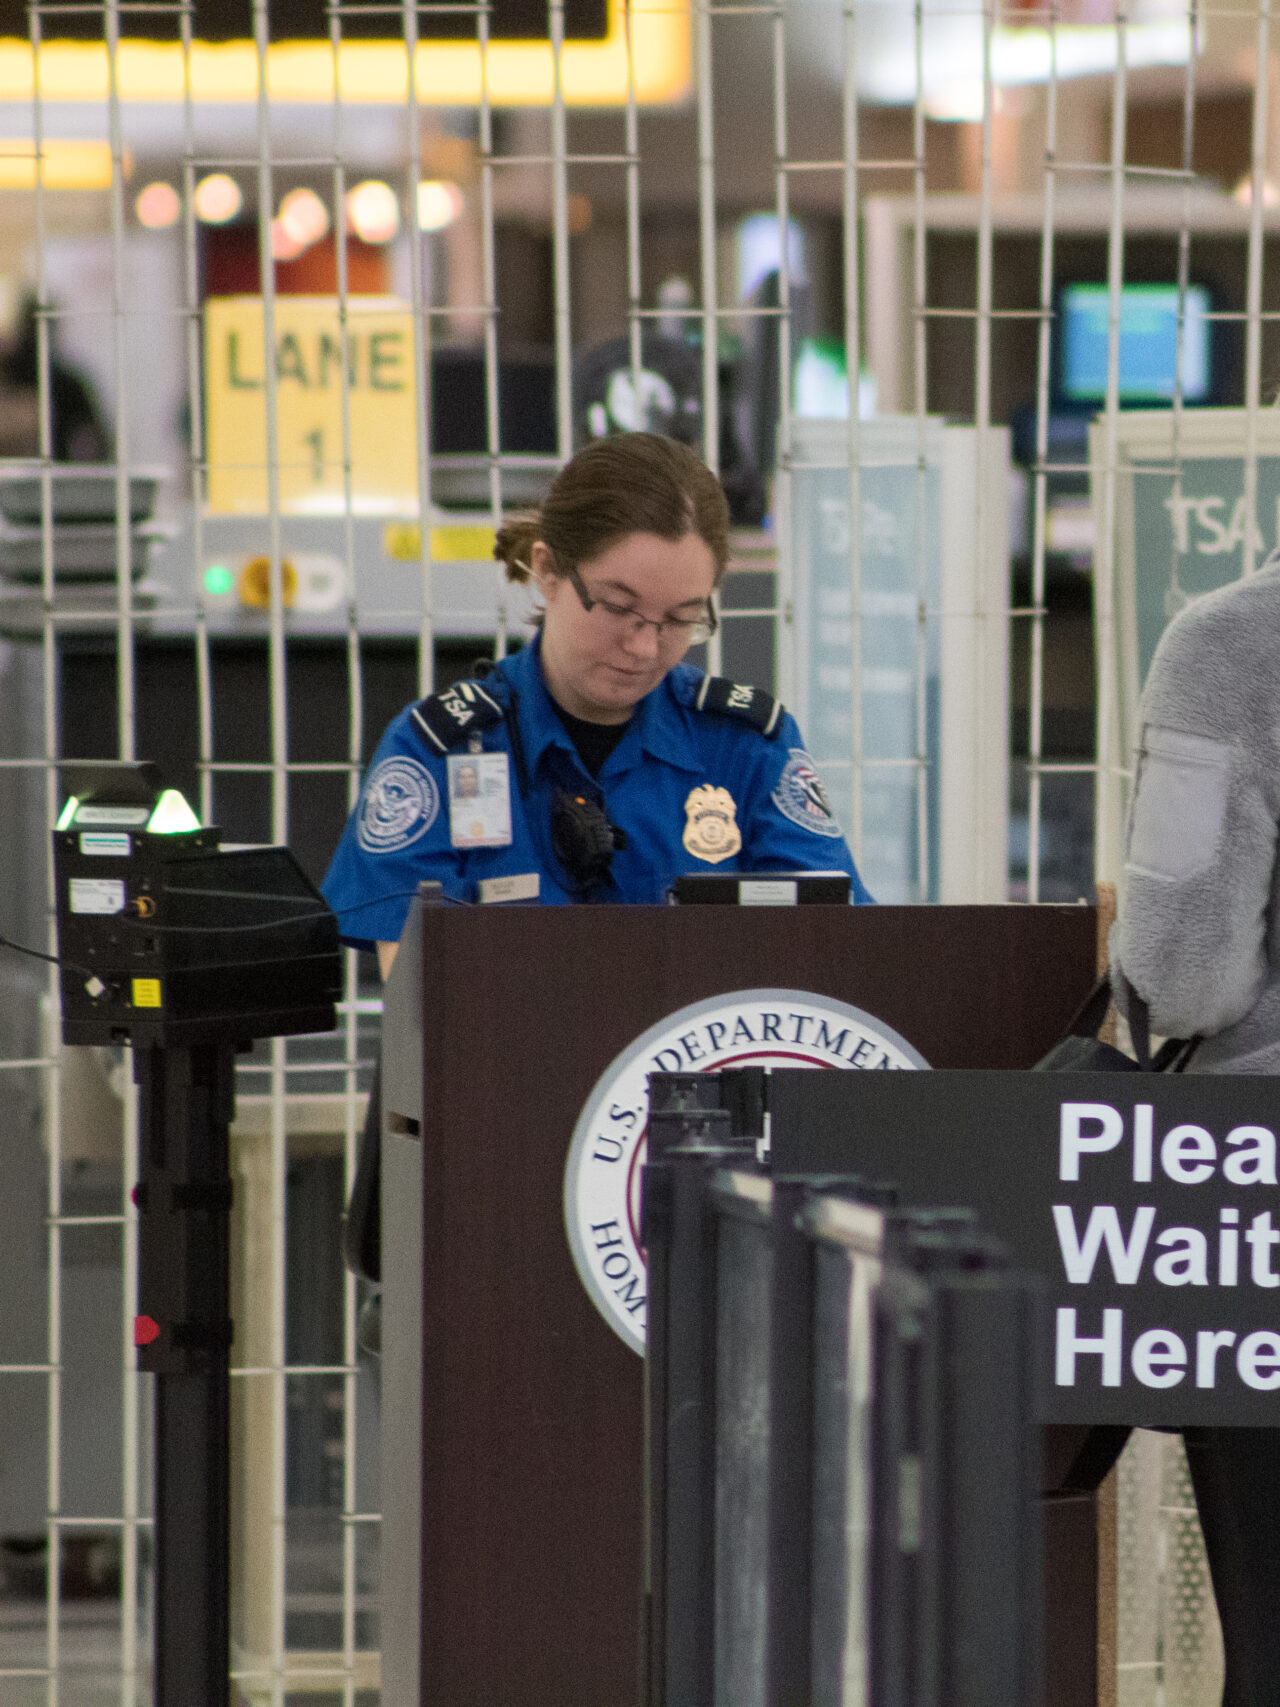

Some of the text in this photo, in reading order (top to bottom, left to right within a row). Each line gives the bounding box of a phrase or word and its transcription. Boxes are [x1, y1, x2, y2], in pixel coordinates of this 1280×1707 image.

[227, 332, 405, 392] LANE
[305, 427, 325, 484] 1
[1165, 496, 1265, 553] TSA
[438, 687, 475, 726] TSA
[727, 683, 754, 708] TSA
[592, 1102, 644, 1163] U.S.
[589, 1218, 647, 1328] HOM
[1052, 1205, 1280, 1288] Wait
